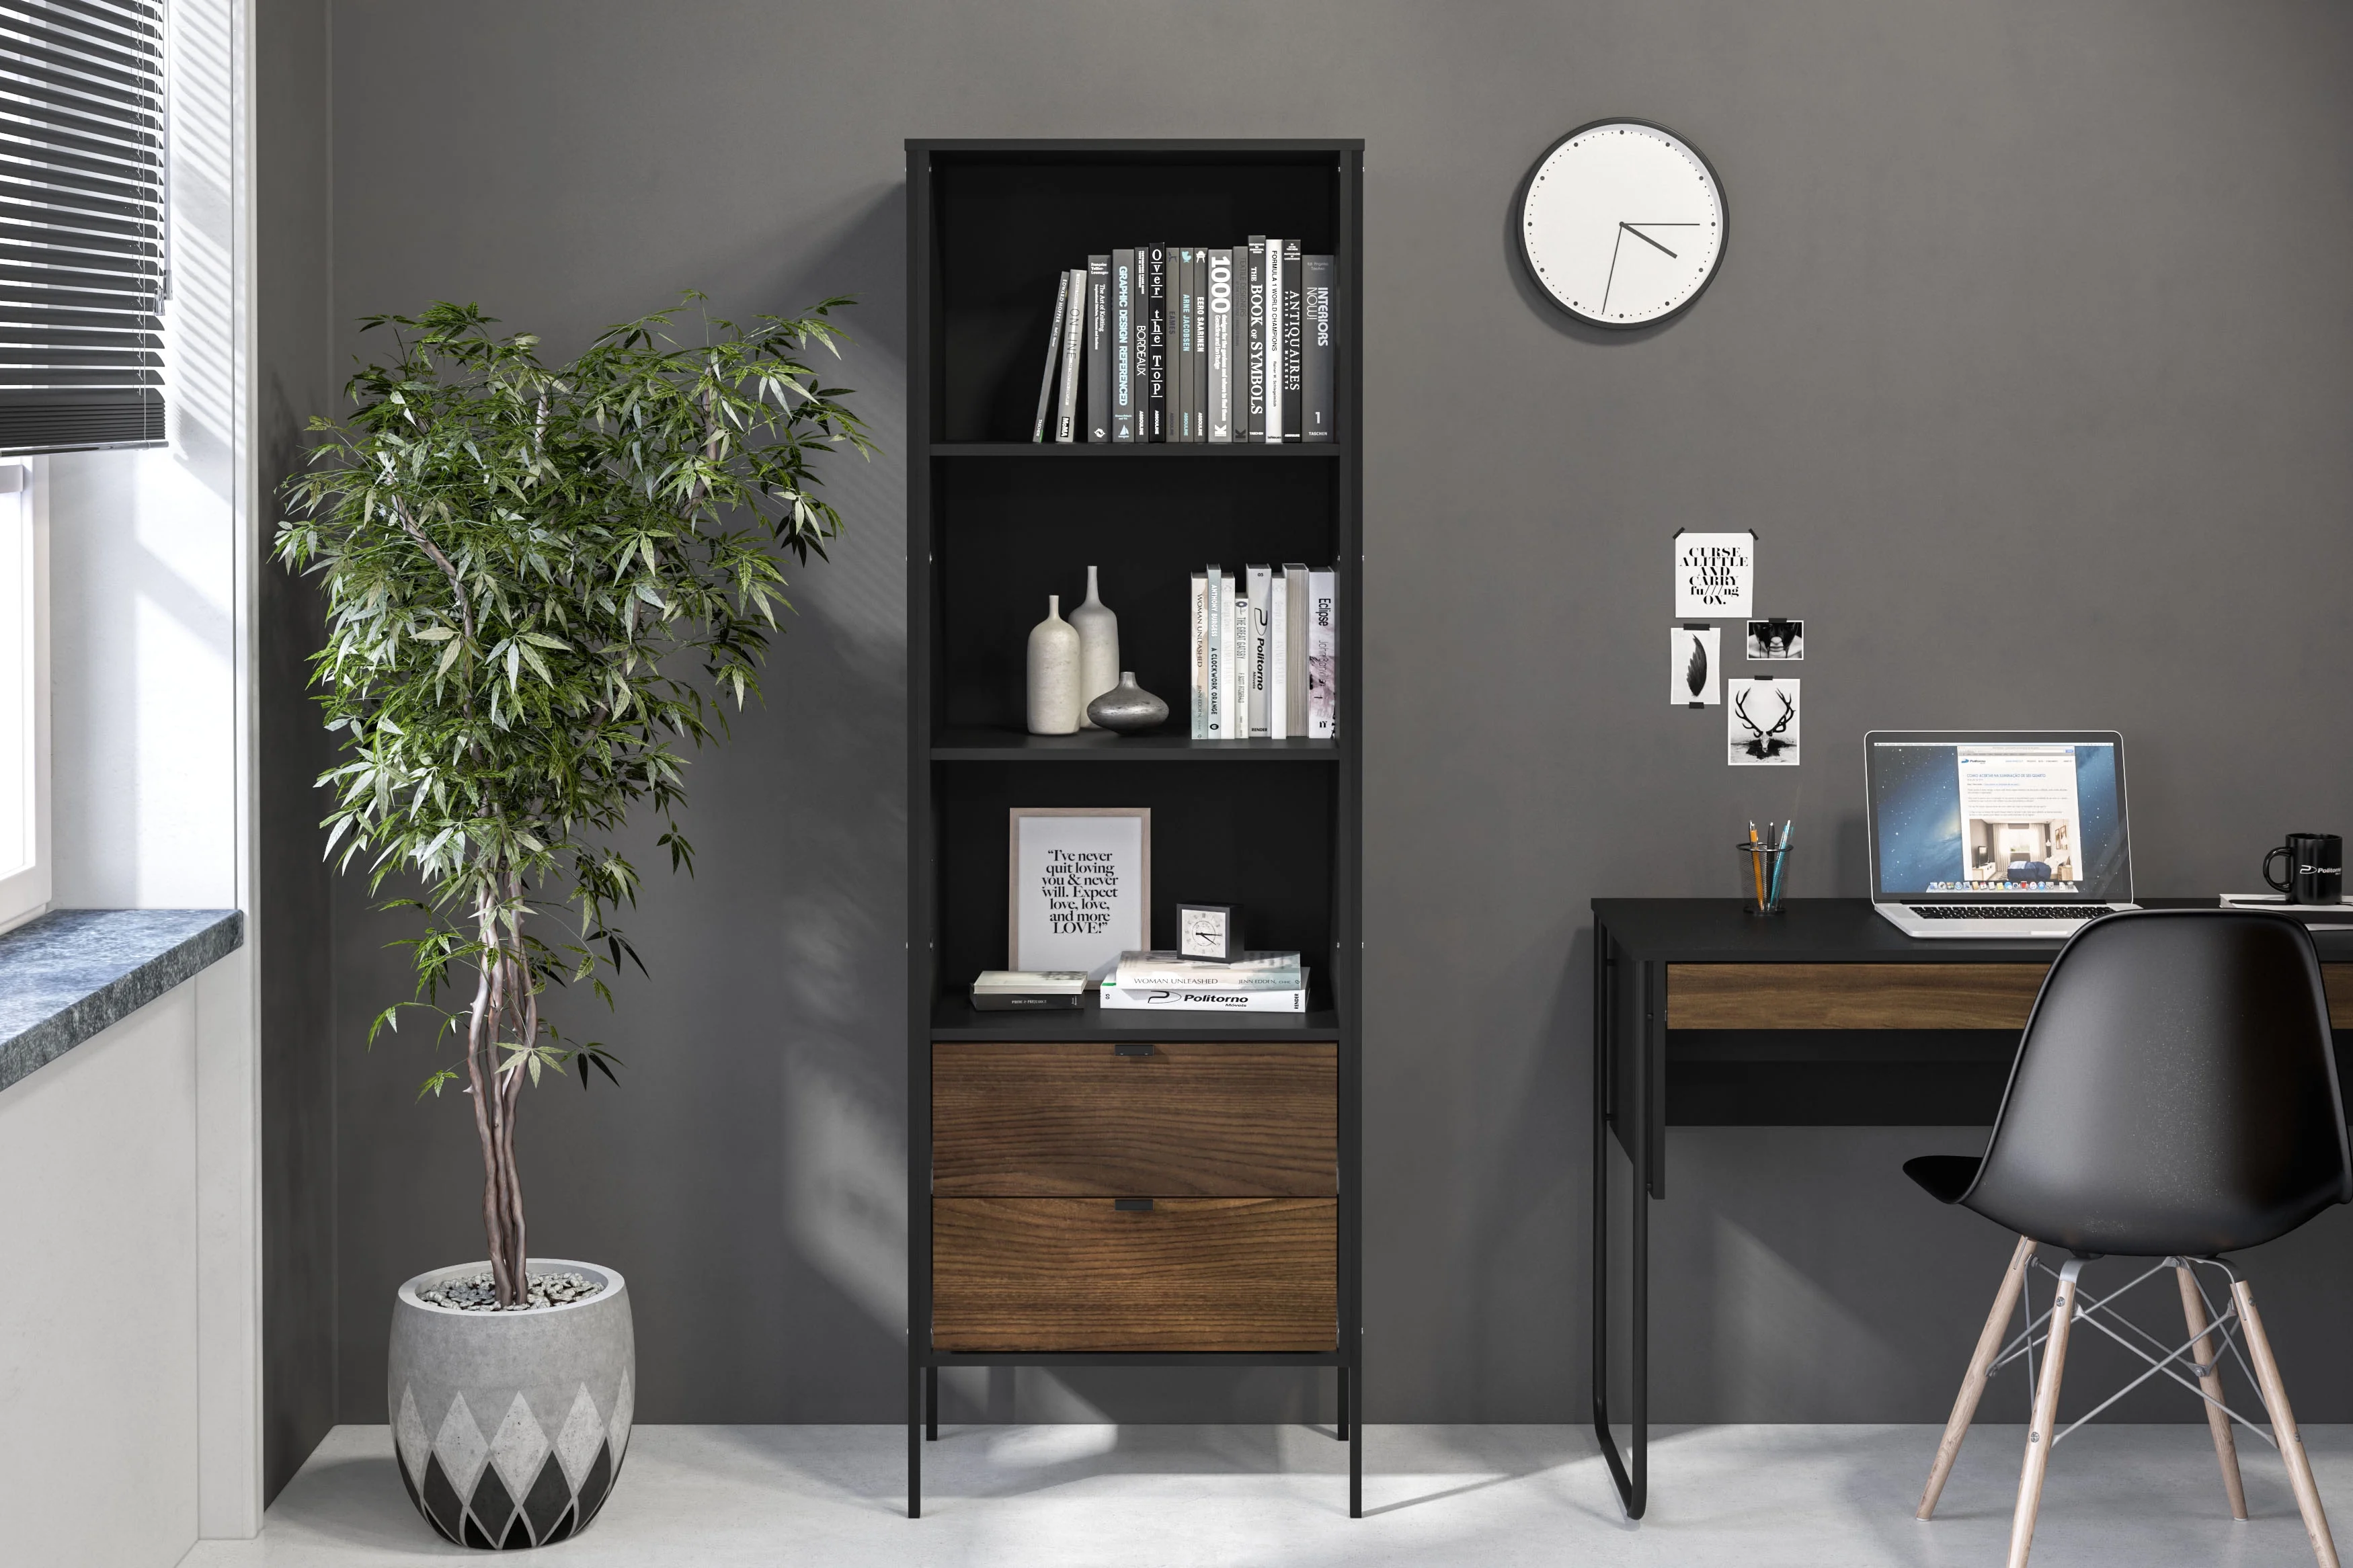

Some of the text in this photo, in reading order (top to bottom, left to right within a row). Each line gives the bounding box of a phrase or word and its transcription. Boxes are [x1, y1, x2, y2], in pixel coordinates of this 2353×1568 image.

[1119, 266, 1127, 307] GRAPHIC
[1211, 255, 1231, 313] 1000
[1055, 280, 1067, 323] EDWARD HOPPER
[1251, 284, 1263, 327] BOOK
[1307, 288, 1317, 320] NOW!
[1068, 308, 1080, 325] ON
[1152, 249, 1162, 395] Over the Top
[1318, 288, 1328, 346] INTERIORS
[1119, 309, 1127, 342] DESIGN
[1250, 329, 1257, 339] OF
[1066, 332, 1078, 359] LINE
[1288, 290, 1300, 390] ANTIQUAIRES
[1137, 325, 1146, 376] BORDEAUX
[1119, 345, 1127, 405] REFERENCED
[1251, 341, 1263, 414] SYMBOLS
[1316, 411, 1320, 423] 1
[1061, 417, 1069, 437] MoMA
[1689, 547, 1741, 557] CURSE
[1679, 557, 1748, 567] A LITTLE
[1698, 567, 1730, 576] AND
[1689, 576, 1739, 585] CARRY
[1691, 585, 1739, 597] fu///ng
[1703, 595, 1726, 605] ON.
[1316, 598, 1331, 626] Eclipse
[1237, 617, 1246, 659] THE GREAT GATSBY
[1318, 640, 1328, 656] John
[1078, 853, 1113, 861] never
[1046, 862, 1115, 876] quit loving
[1042, 874, 1119, 888] you & never
[1042, 886, 1119, 901] will. Expect
[1049, 899, 1110, 911] love, love,
[1049, 911, 1111, 921] and more
[1184, 994, 1248, 1003] Politorno
